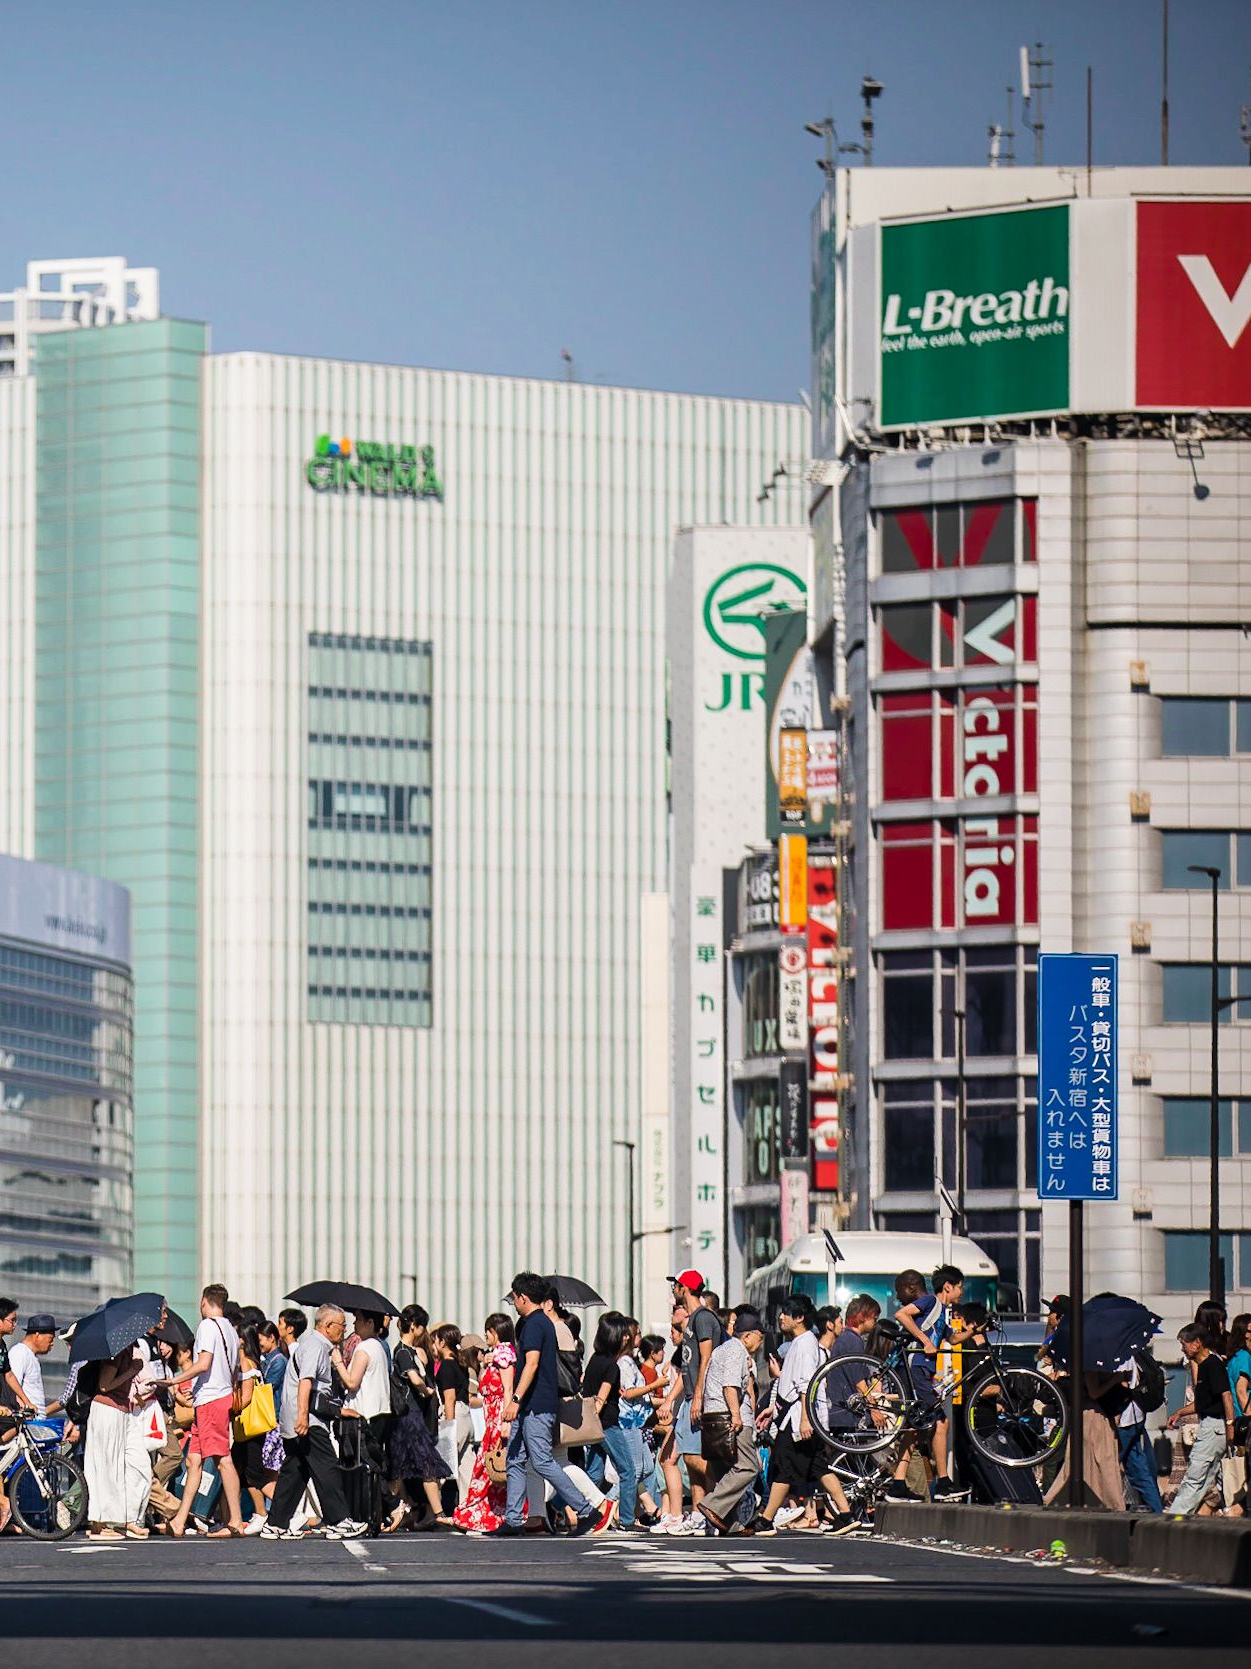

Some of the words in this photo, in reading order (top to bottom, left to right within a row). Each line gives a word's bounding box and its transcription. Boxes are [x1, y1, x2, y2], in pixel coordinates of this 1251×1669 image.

[907, 333, 928, 350] the
[307, 457, 444, 500] CINEMA
[963, 598, 1016, 917] Vctoria
[696, 895, 718, 1291] 豪華カプセルホテ
[1046, 1088, 1066, 1191] 入れません
[1068, 1005, 1088, 1149] バスタ新宿へは
[1091, 966, 1111, 1191] 一般車・貸切バス・大型貨物車は
